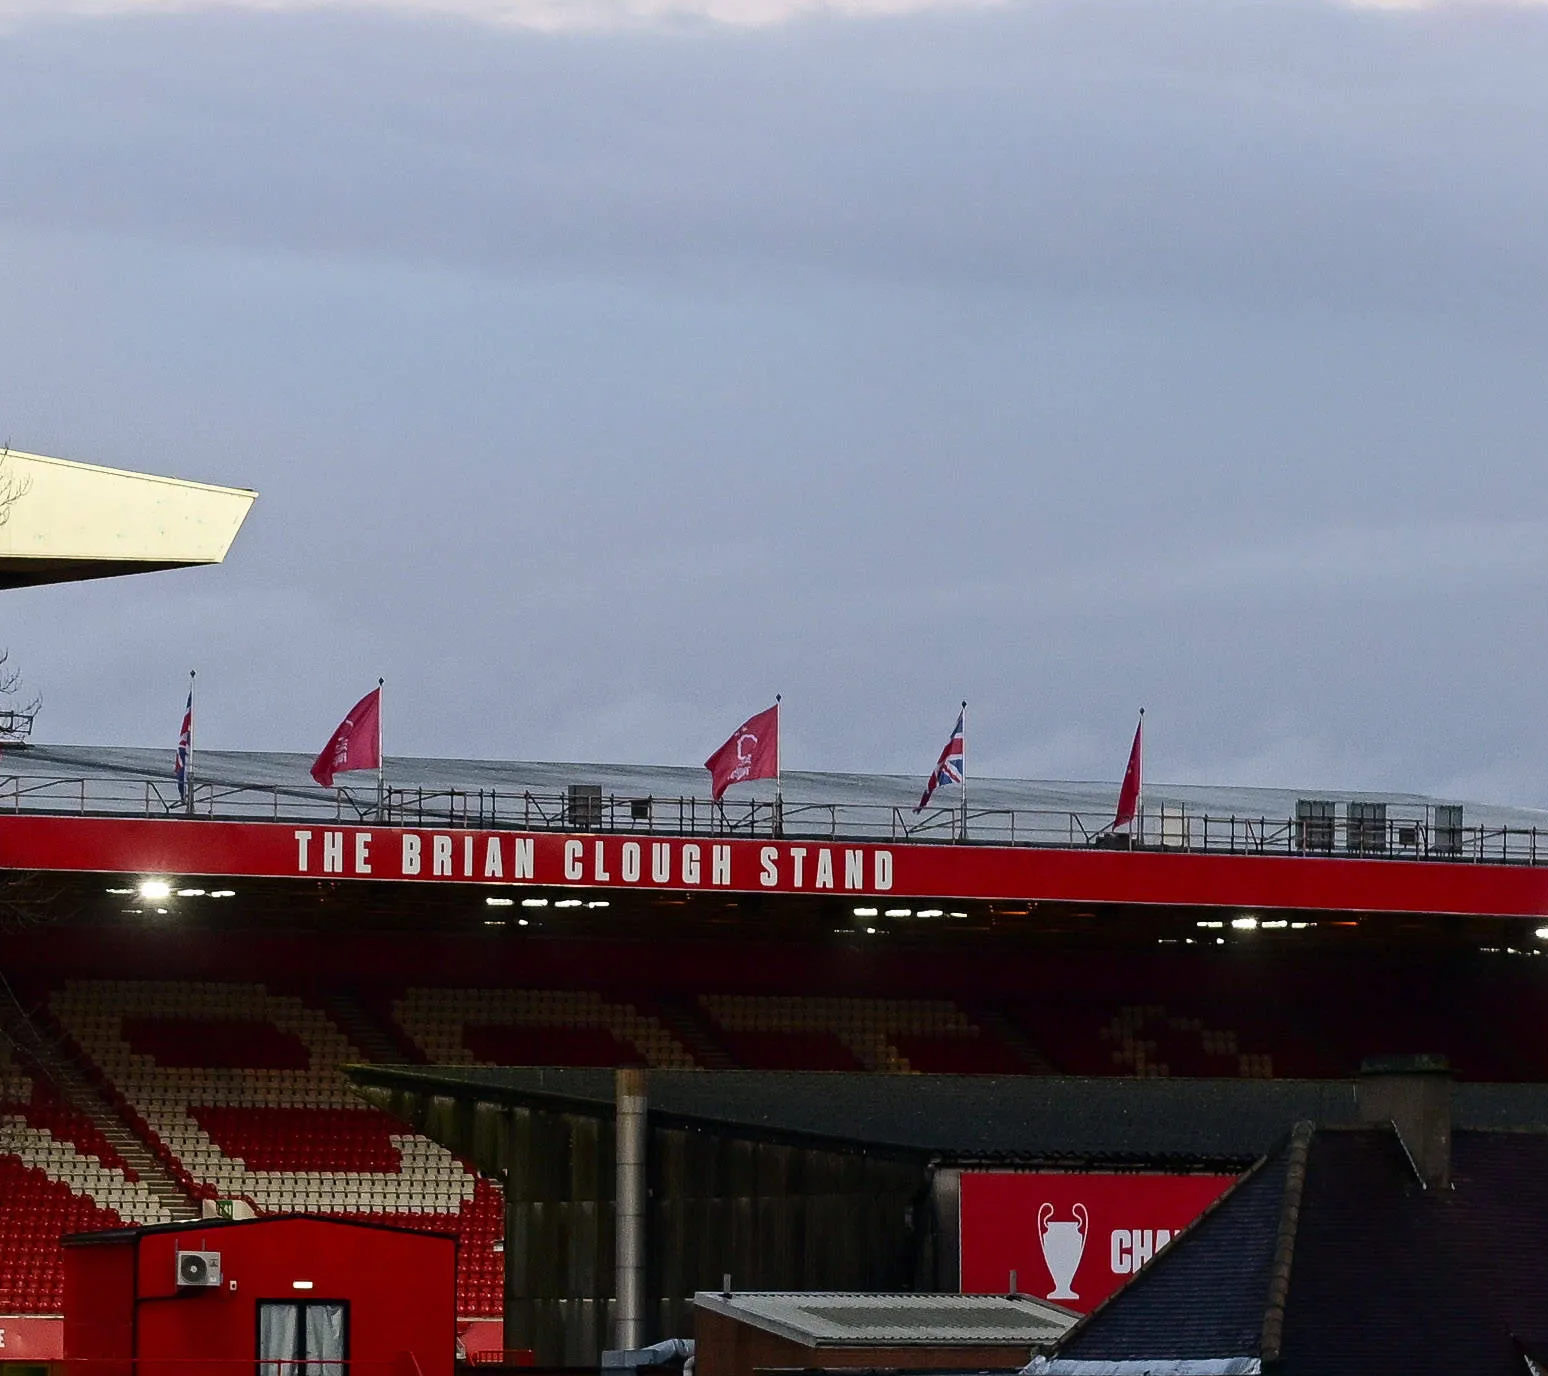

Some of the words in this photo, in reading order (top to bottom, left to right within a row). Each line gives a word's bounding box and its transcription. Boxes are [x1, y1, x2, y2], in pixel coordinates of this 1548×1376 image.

[295, 830, 373, 873] THE
[402, 833, 535, 879] BRIAN
[564, 839, 732, 886] CLOUGH
[760, 844, 893, 890] STAND
[1111, 1229, 1181, 1274] CHA
